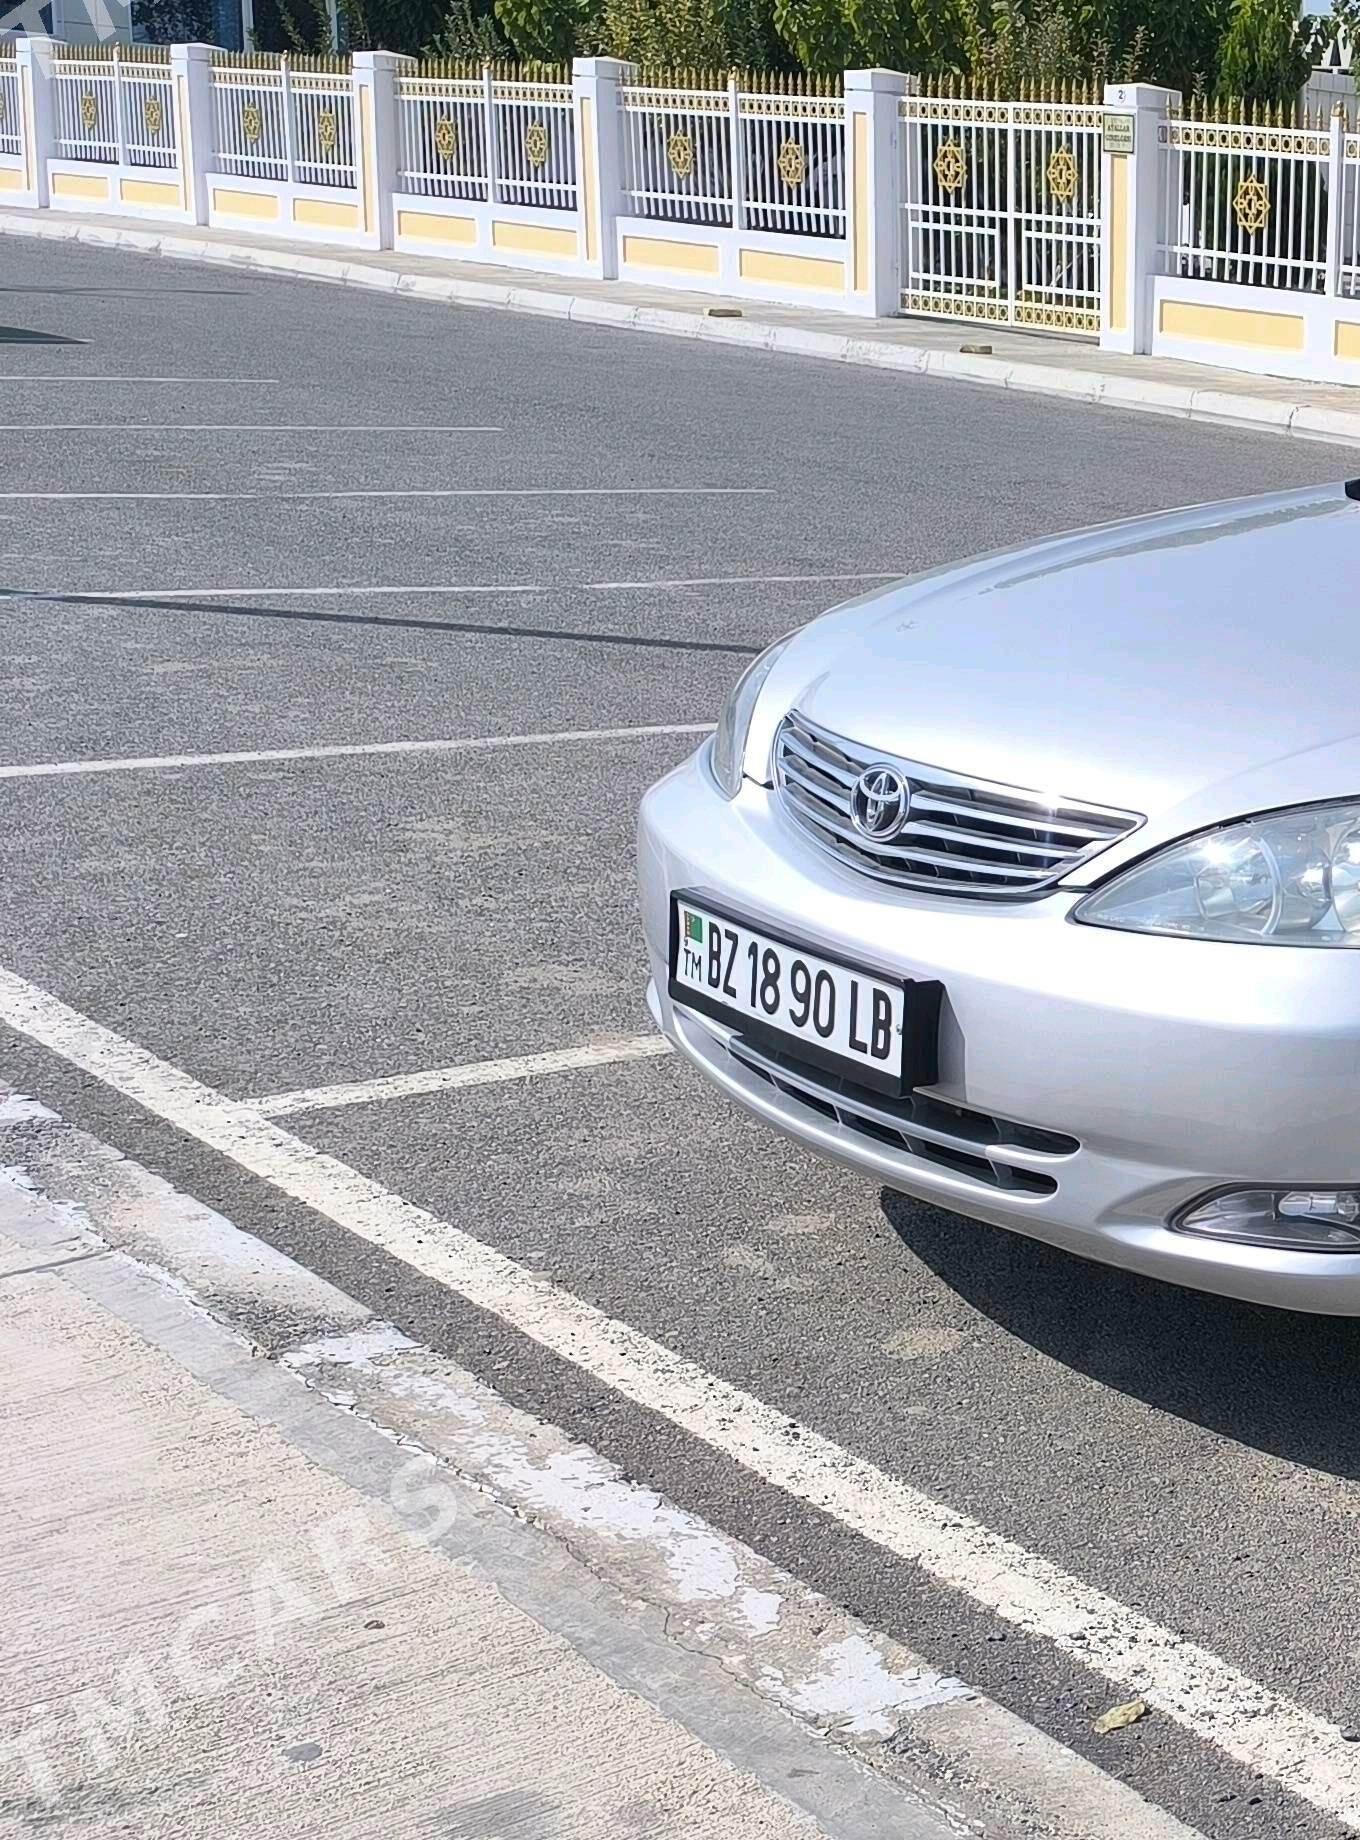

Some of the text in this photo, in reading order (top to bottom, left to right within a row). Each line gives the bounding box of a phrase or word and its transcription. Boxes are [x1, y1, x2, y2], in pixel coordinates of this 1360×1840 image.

[683, 947, 702, 983] TM
[707, 921, 892, 1061] BZ 18 90 LB
